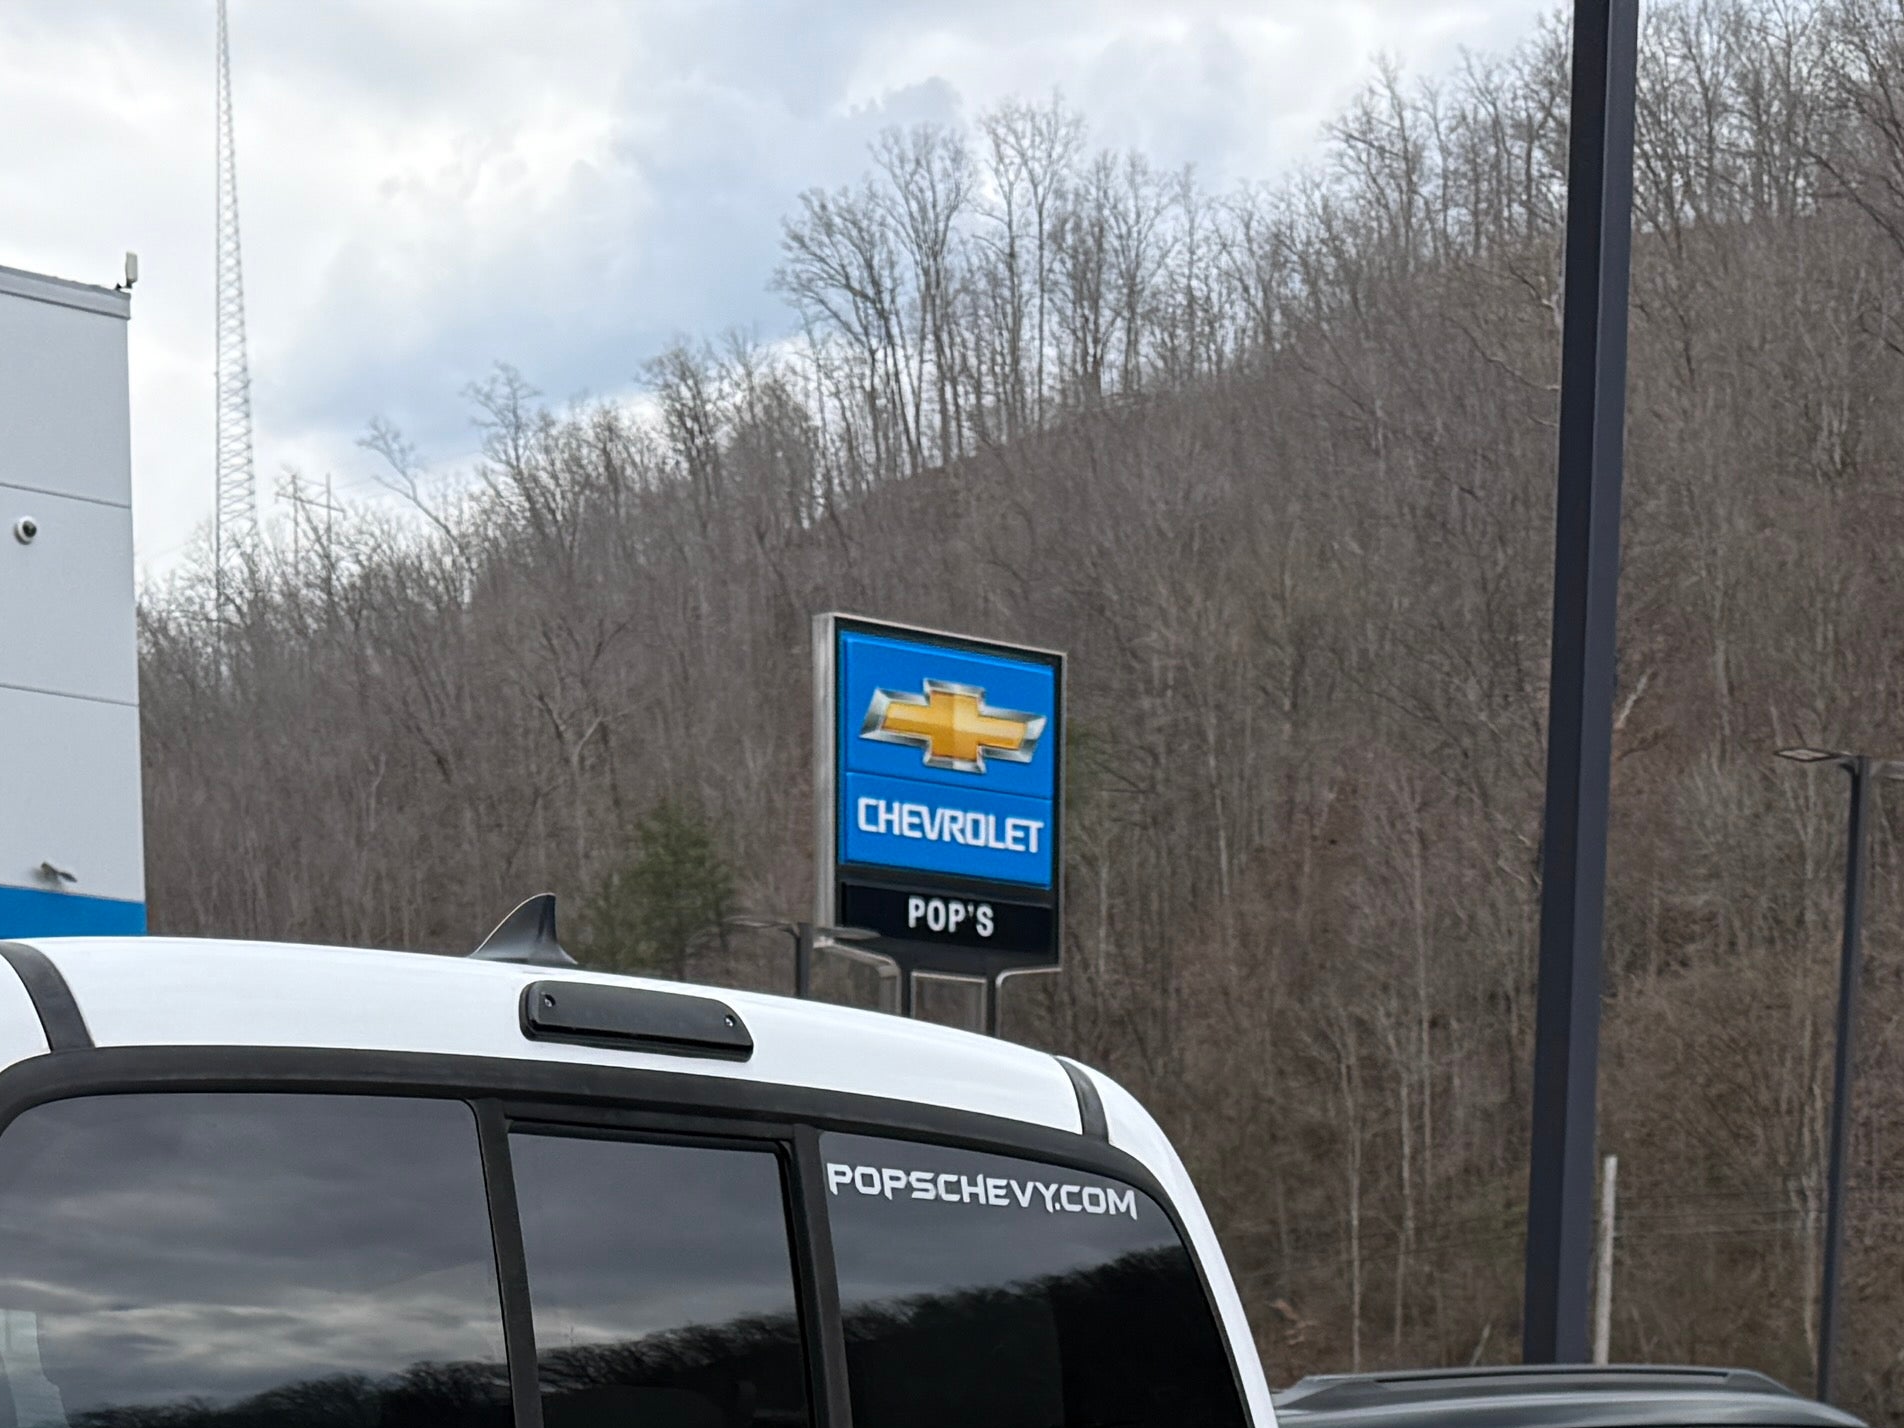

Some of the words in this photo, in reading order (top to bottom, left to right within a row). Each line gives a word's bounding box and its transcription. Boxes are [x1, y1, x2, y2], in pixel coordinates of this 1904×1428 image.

[857, 796, 1044, 853] CHEVROLET
[907, 895, 995, 937] POP'S
[826, 1161, 1138, 1221] POPSCHEVY.COM
